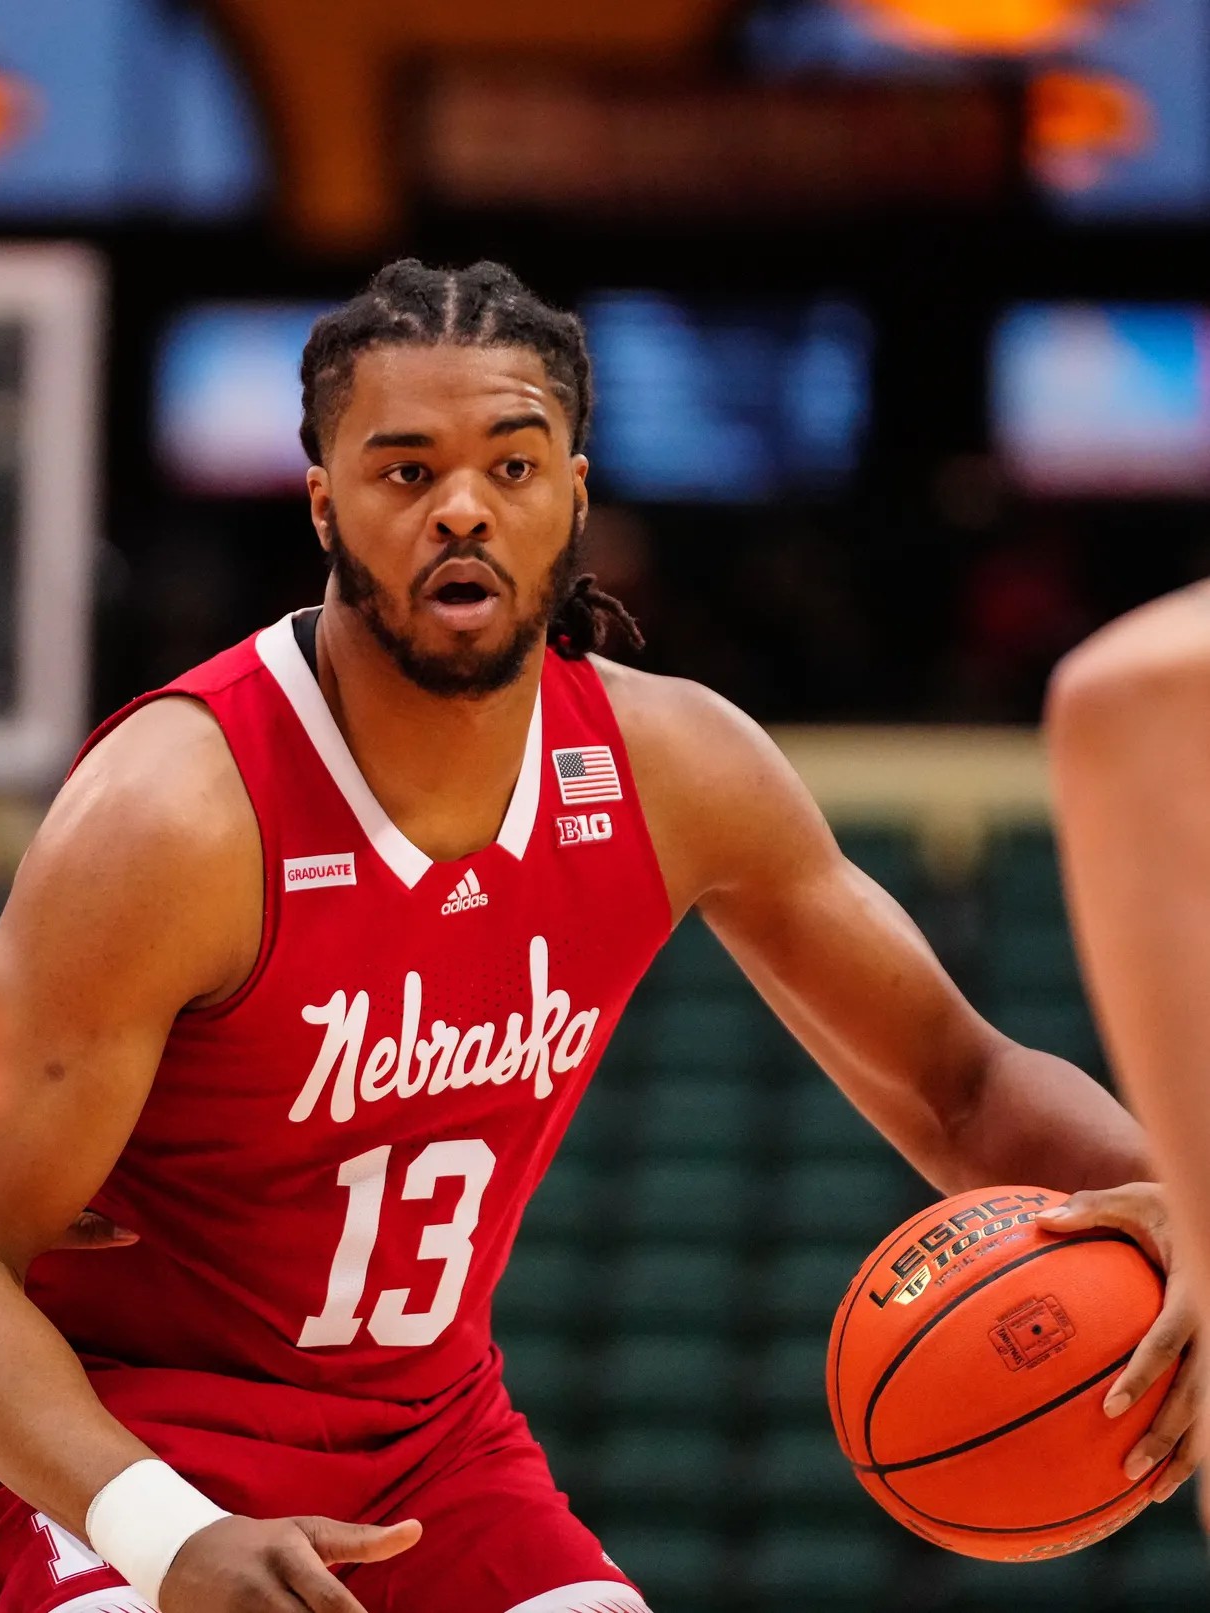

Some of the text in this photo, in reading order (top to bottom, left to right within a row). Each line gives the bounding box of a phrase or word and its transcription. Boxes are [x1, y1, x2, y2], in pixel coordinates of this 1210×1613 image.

[287, 863, 352, 882] GRADUATE
[441, 893, 489, 916] adidas
[288, 935, 601, 1122] Nebraska
[296, 1138, 496, 1347] 13
[869, 1193, 1050, 1308] LEGACY
[895, 1268, 930, 1300] TF
